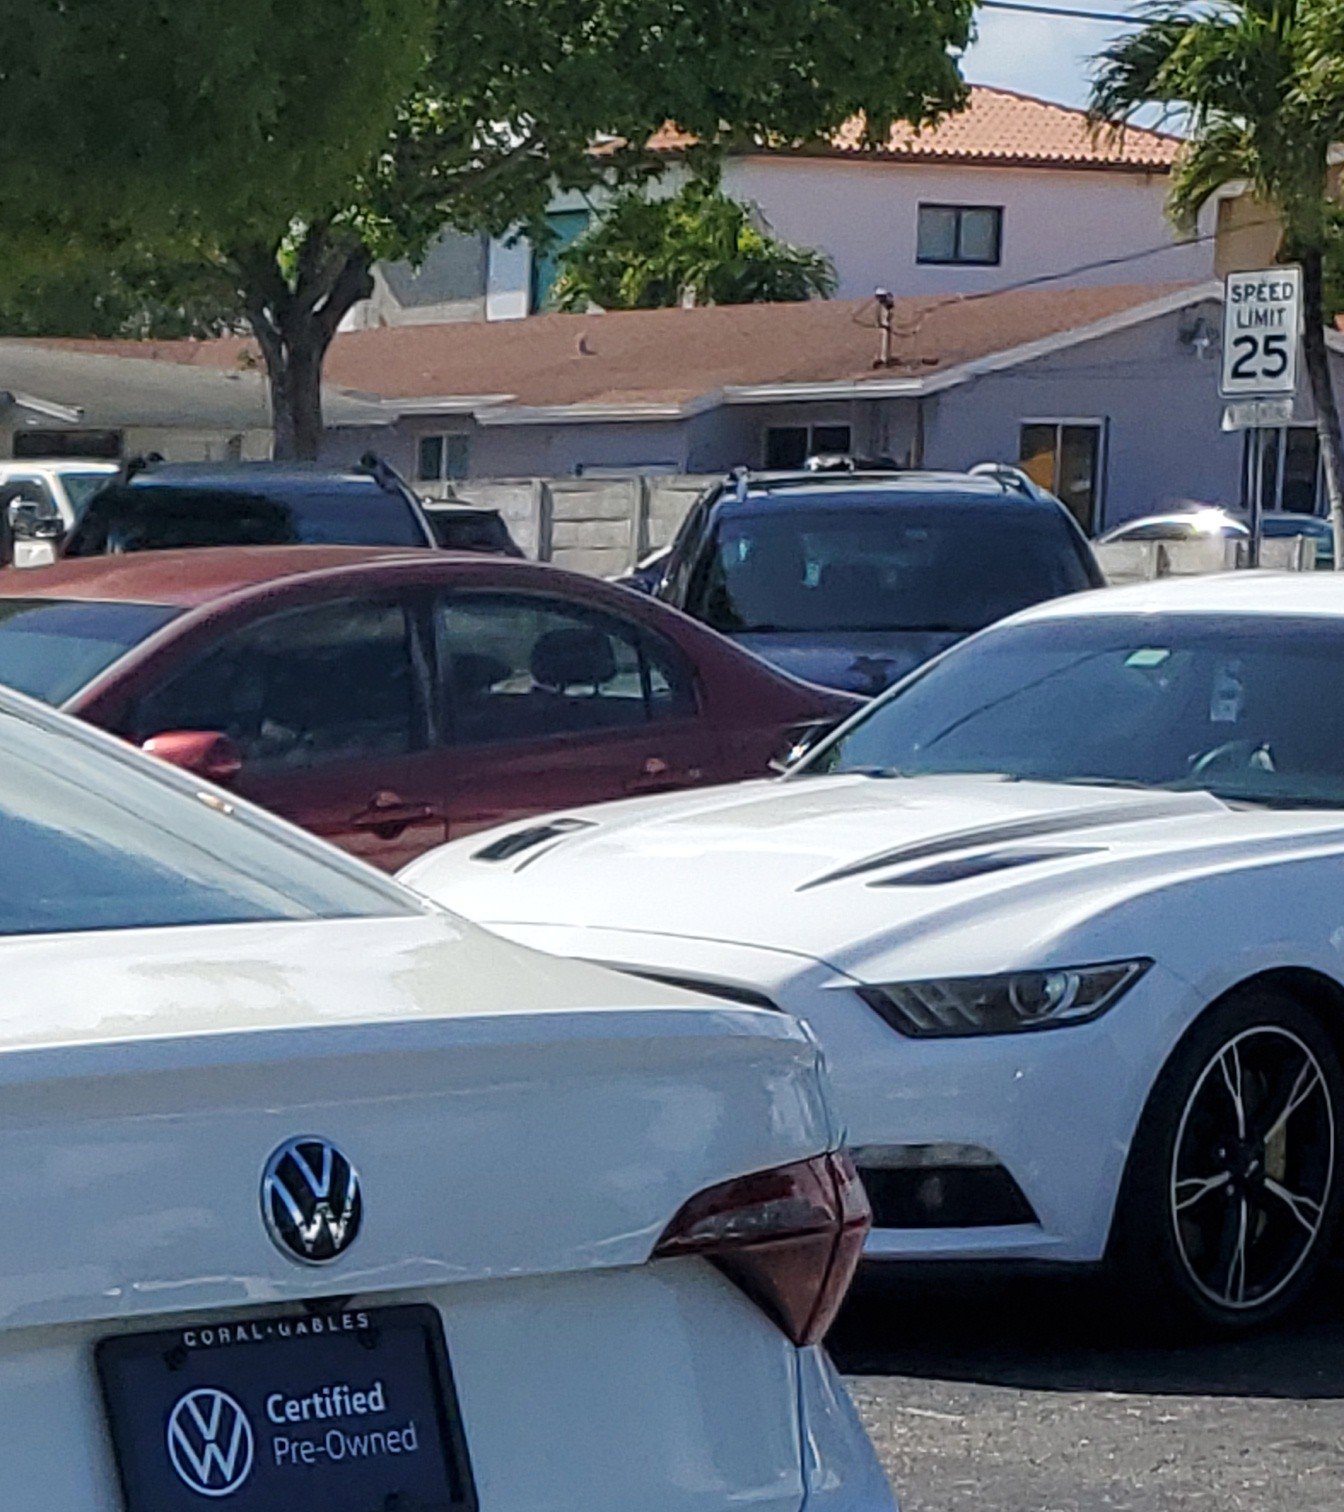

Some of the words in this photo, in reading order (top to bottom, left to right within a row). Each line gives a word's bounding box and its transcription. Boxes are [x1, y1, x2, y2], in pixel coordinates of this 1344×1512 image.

[1231, 282, 1294, 304] SPEED
[1237, 308, 1286, 329] LIMIT
[1231, 334, 1288, 379] 25
[263, 1138, 360, 1260] VW
[266, 1381, 387, 1424] Certified
[169, 1390, 252, 1494] VW
[273, 1421, 419, 1466] Pre-Owned
